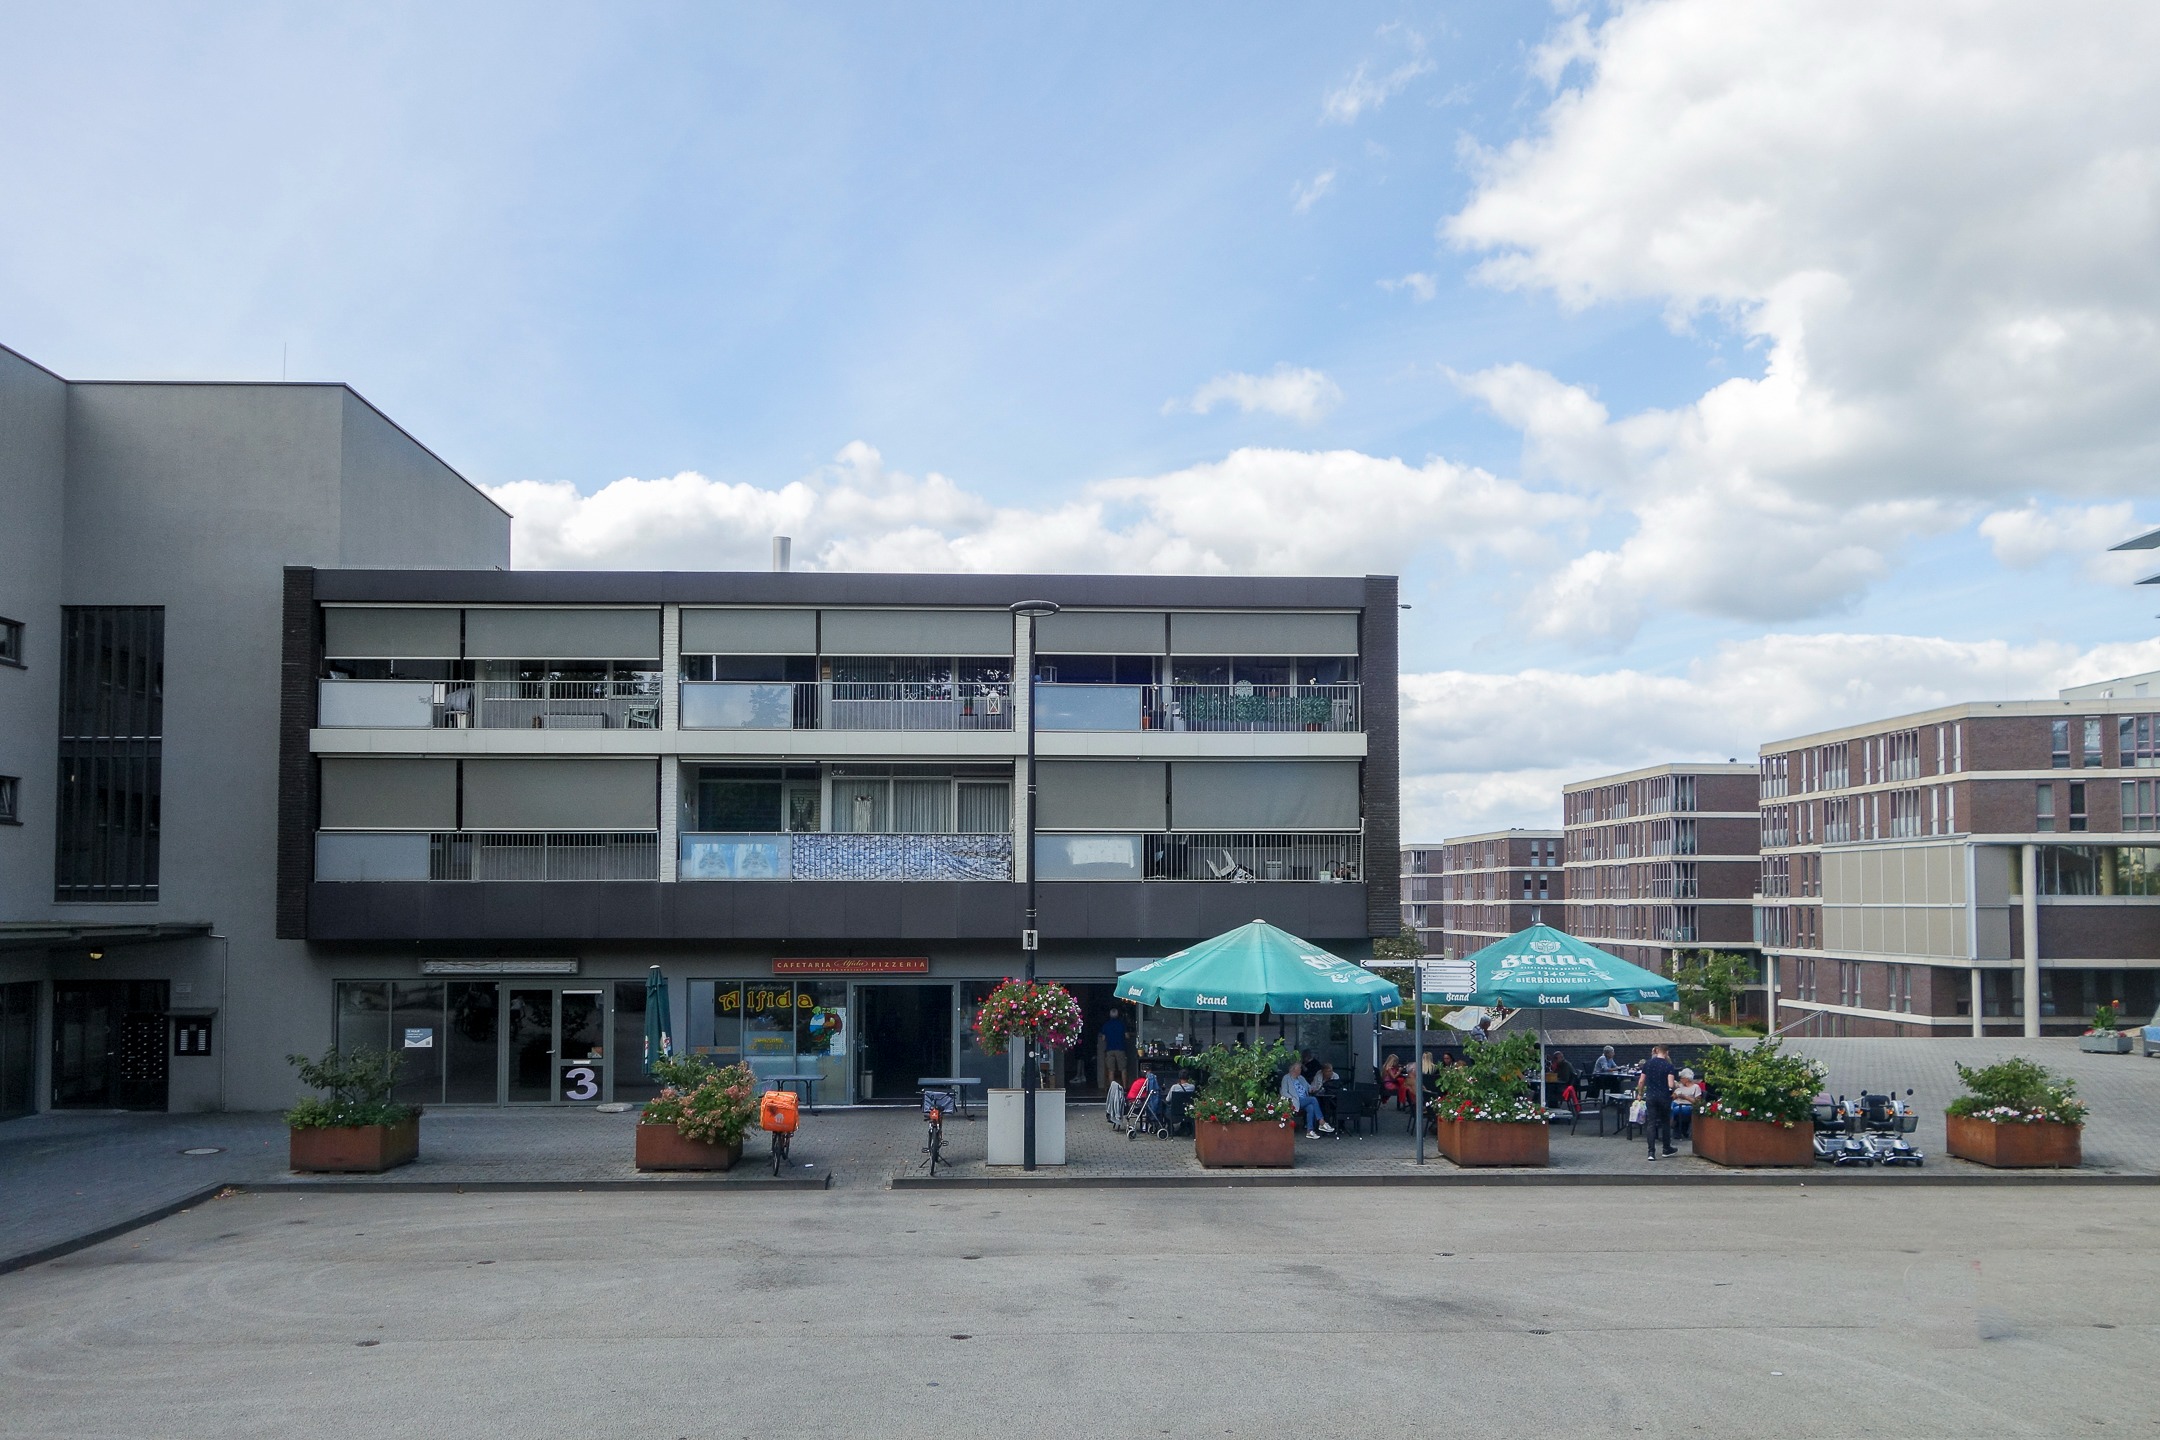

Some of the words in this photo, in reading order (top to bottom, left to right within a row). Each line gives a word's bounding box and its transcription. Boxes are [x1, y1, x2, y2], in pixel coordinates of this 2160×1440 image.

[719, 990, 813, 1012] Alfida
[1196, 994, 1228, 1006] Brand
[1446, 992, 1470, 1002] Brand
[1538, 993, 1570, 1004] Brand
[1303, 998, 1333, 1010] Brand
[566, 1068, 598, 1100] 3
